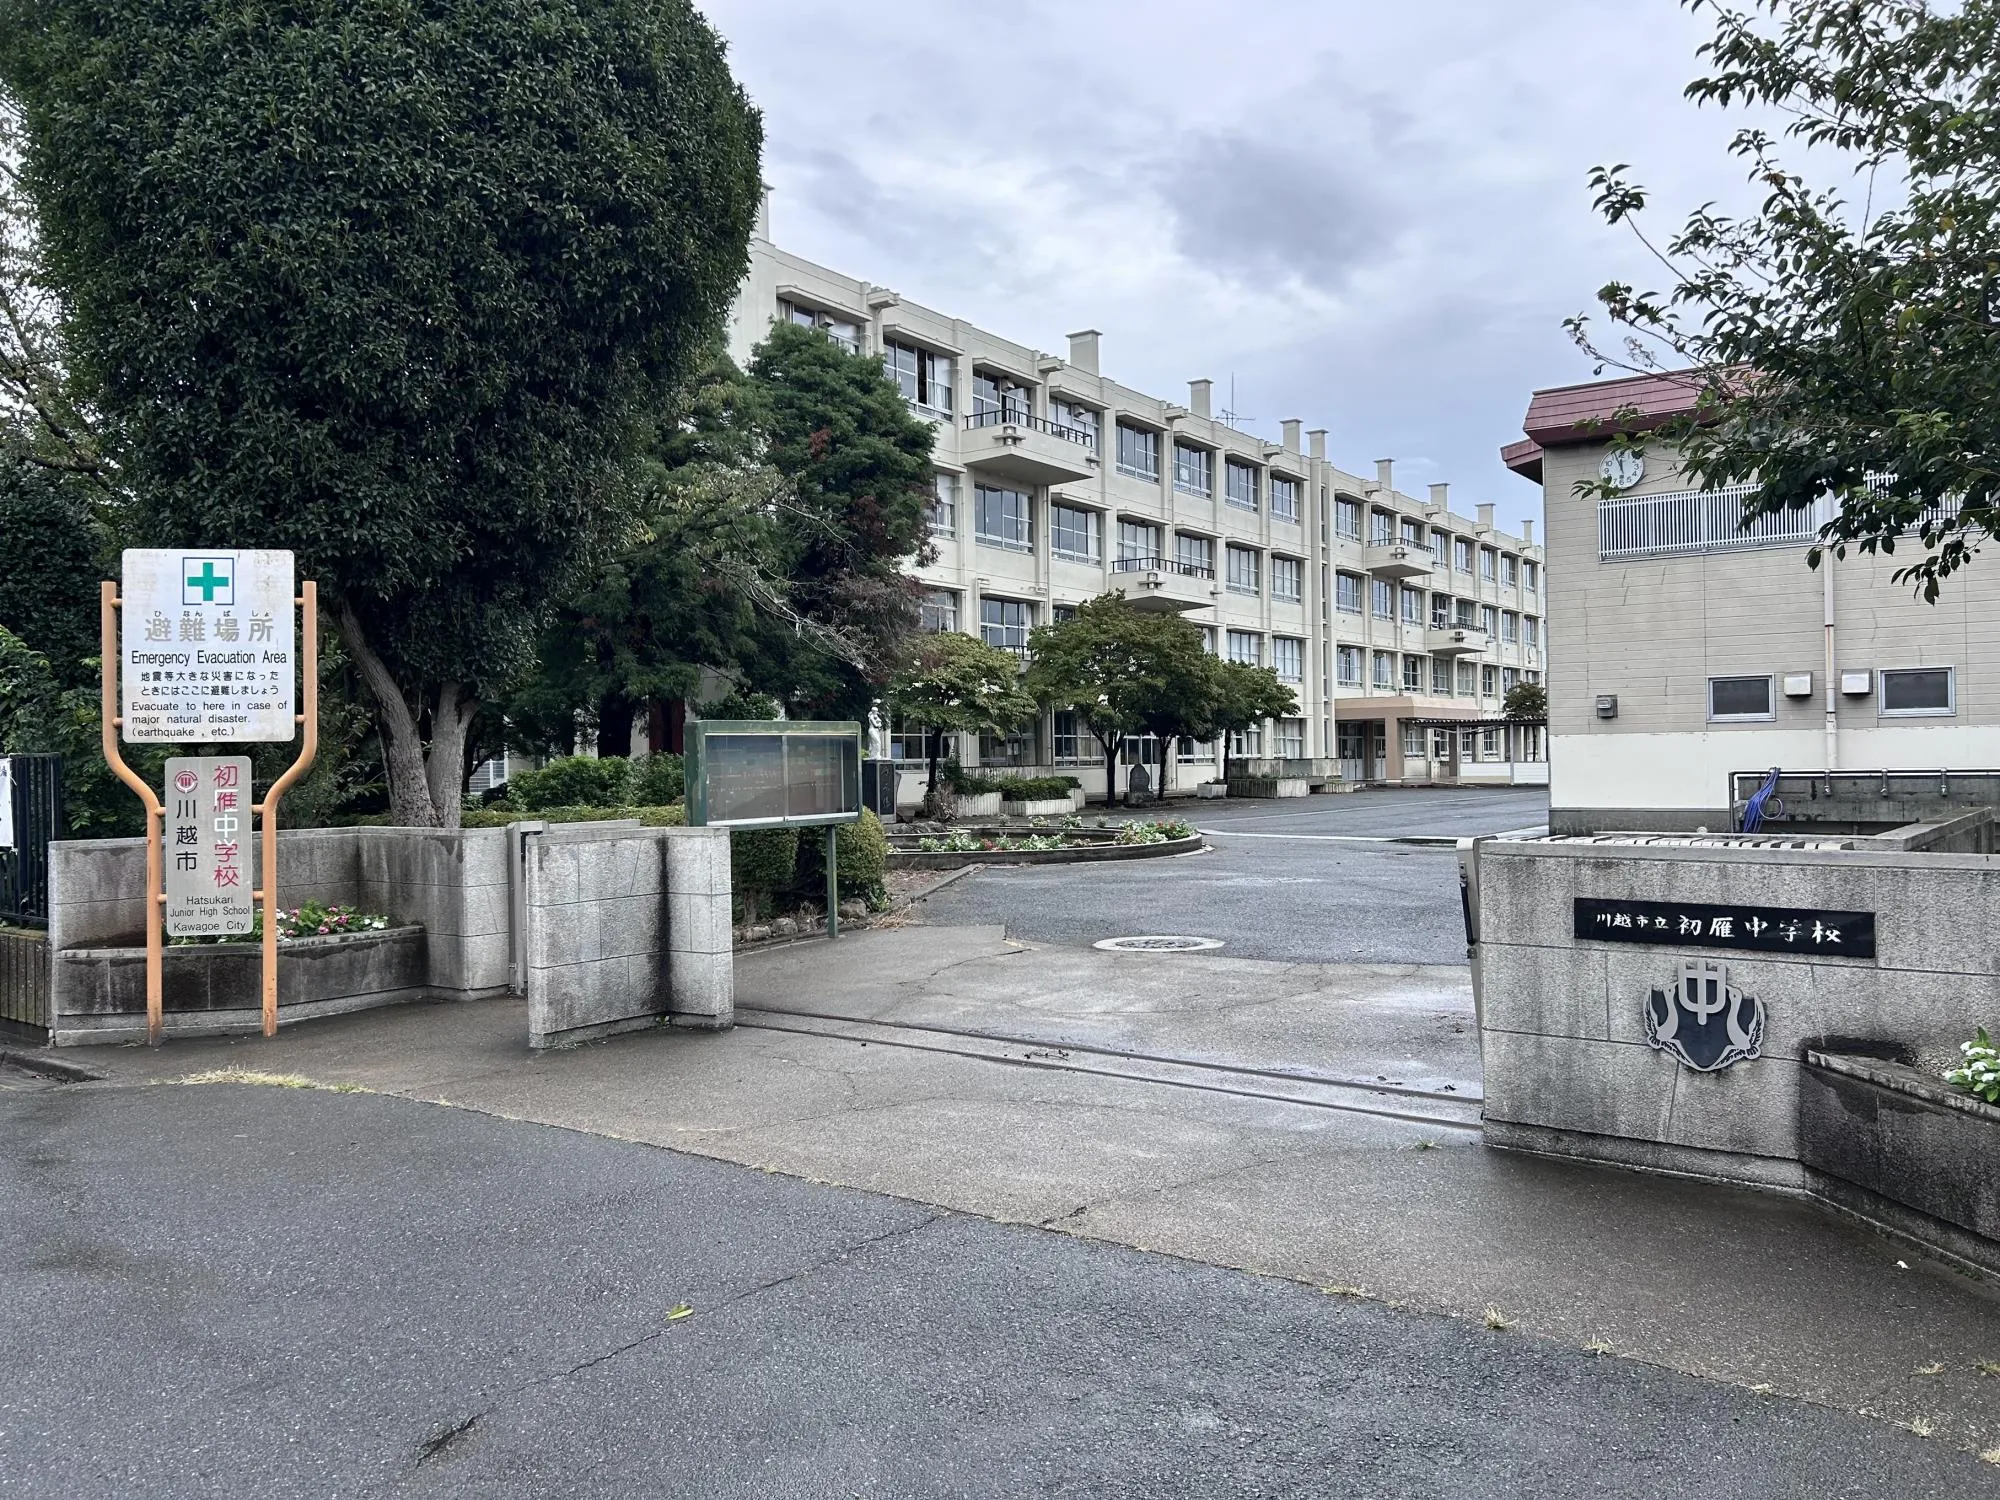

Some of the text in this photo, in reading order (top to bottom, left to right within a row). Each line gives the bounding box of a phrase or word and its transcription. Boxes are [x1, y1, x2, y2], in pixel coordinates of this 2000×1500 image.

[144, 618, 274, 642] 避難場所
[132, 650, 287, 666] Emergency Evacuation Area
[141, 671, 279, 681] 地震等大きな災害になった
[141, 685, 279, 696] ときにはここに避難しましょう
[132, 701, 288, 711] Evacuate to here in case of
[132, 715, 250, 725] major natural disaster.
[132, 728, 194, 738] (earthquake
[211, 728, 235, 736] etc.)
[213, 765, 239, 888] 初雁中学校
[176, 799, 198, 871] 川越市
[187, 896, 233, 905] Hatsukari
[170, 907, 250, 917] Junior High School
[174, 921, 246, 932] Kawagoe City
[1596, 913, 1843, 944] 川越市立初雁中学校
